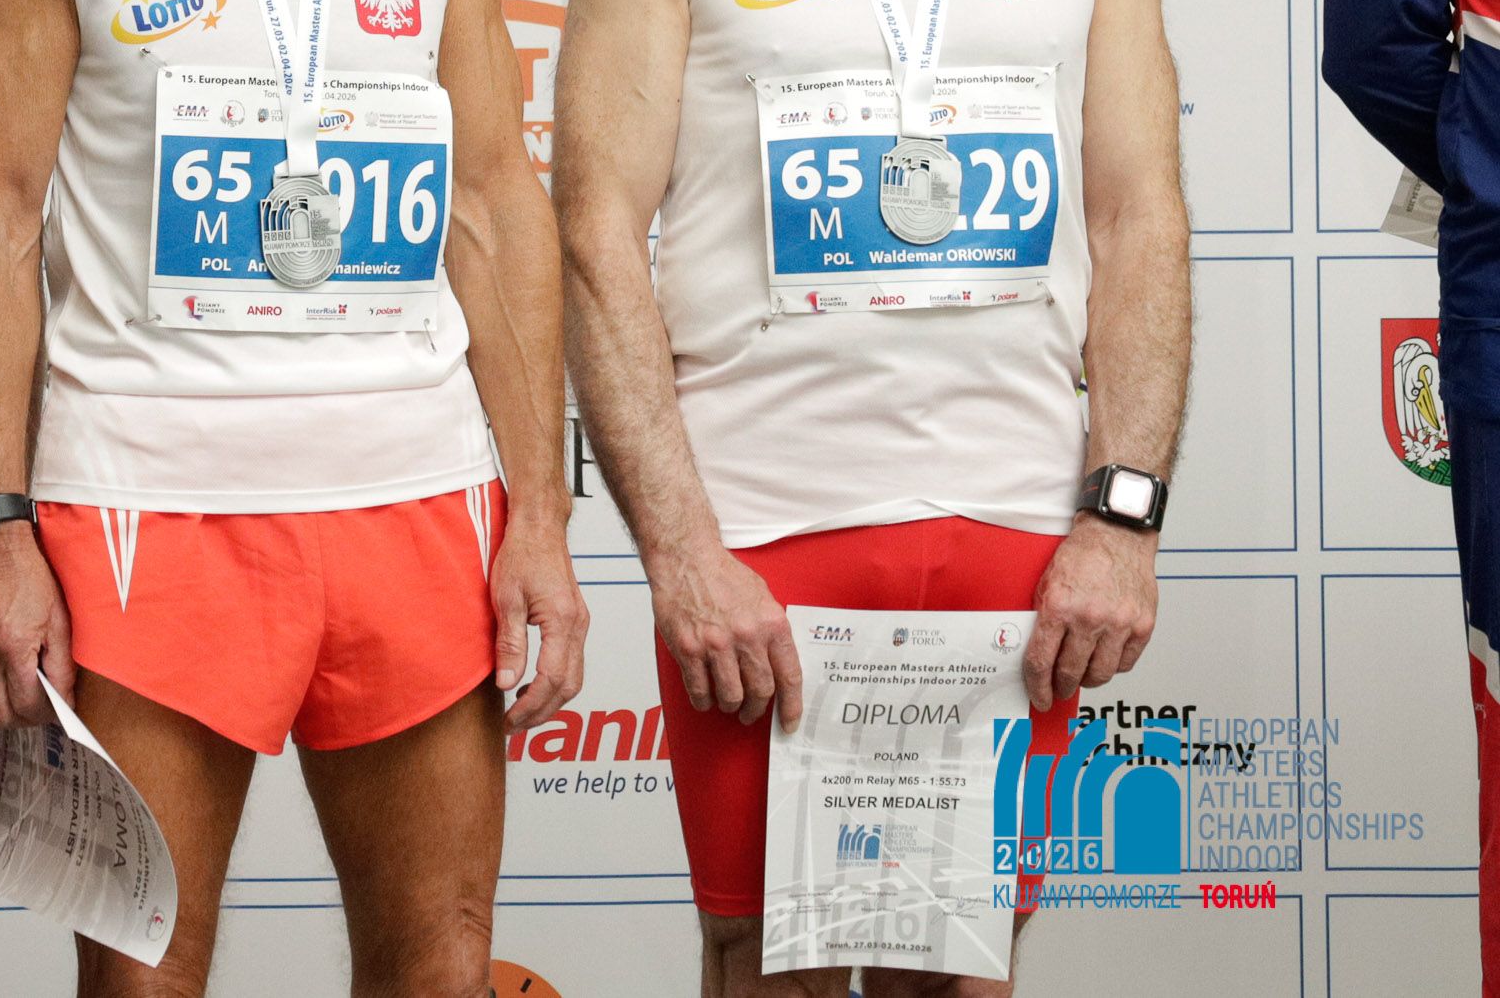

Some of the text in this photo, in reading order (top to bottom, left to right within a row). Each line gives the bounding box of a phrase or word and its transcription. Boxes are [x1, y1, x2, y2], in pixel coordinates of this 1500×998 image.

[309, 8, 322, 46] Masters
[923, 17, 937, 56] European
[305, 46, 318, 88] European
[182, 75, 428, 92] 15. European Championships Indoor
[781, 75, 1035, 93] 15. European Masters Indoor
[172, 149, 251, 203] 65
[781, 148, 863, 200] 65
[194, 210, 228, 244] M
[809, 207, 843, 241] M
[201, 258, 231, 271] POL
[824, 249, 942, 266] POL Waldemar
[870, 295, 905, 306] ANIRO
[247, 306, 282, 316] ANIRO
[306, 307, 336, 315] InterRisk
[823, 661, 997, 673] 15. European Masters Athletics
[829, 673, 987, 686] Championships Indoor 2026
[842, 703, 961, 725] DIPLOMA
[874, 753, 919, 761] POLAND
[533, 769, 657, 800] we help to
[821, 775, 851, 784] 4x200
[867, 776, 895, 786] Relay
[899, 777, 919, 785] M65
[930, 778, 966, 786] 1:55.73
[824, 796, 960, 810] SILVER MEDALIST
[65, 774, 80, 858] MEDALIST
